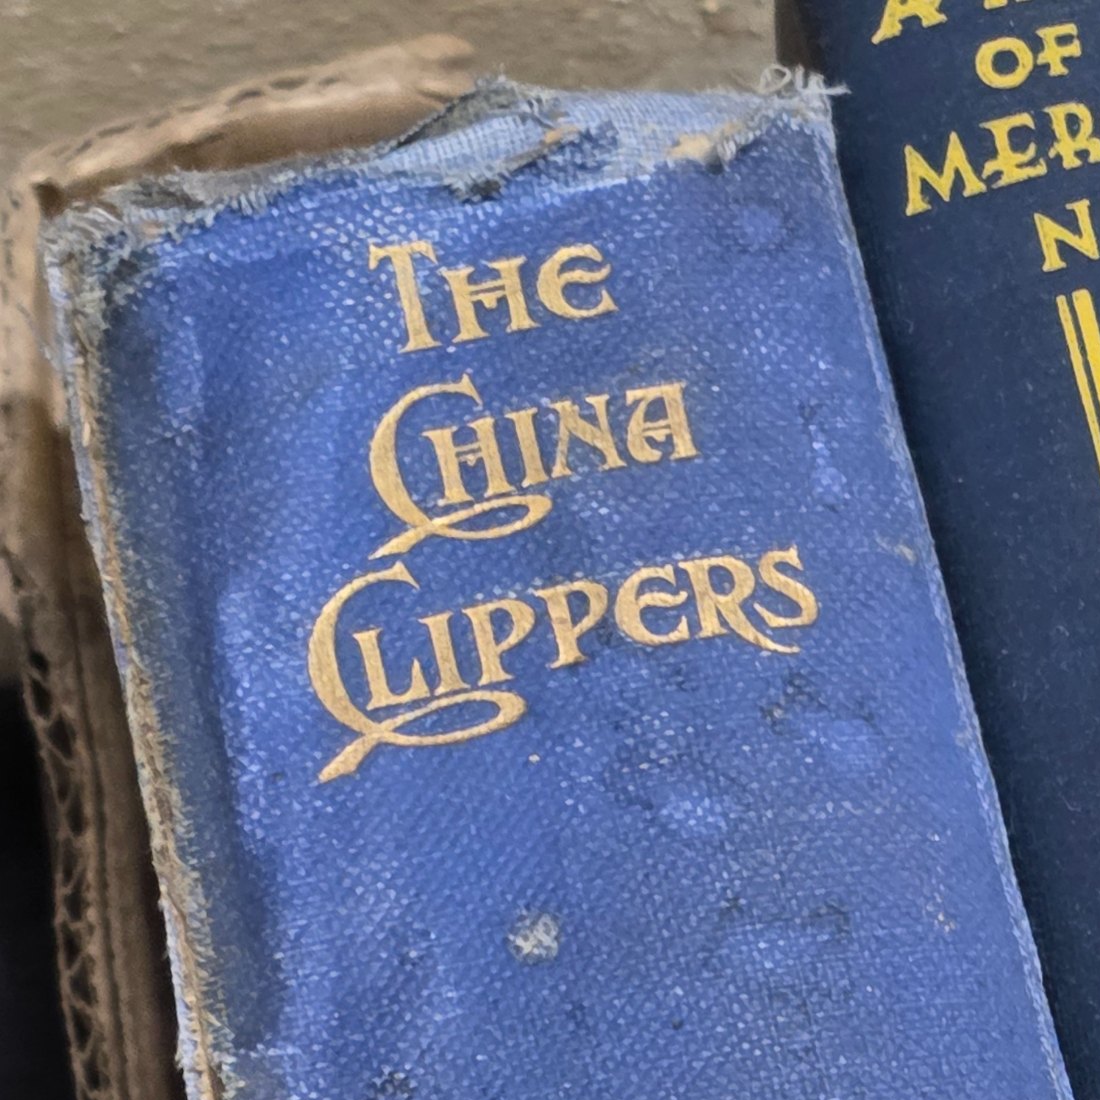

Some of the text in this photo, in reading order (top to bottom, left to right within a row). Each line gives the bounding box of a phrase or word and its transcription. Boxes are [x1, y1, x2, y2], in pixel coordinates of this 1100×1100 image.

[974, 23, 1082, 88] OF
[368, 240, 619, 353] THE
[368, 368, 701, 560] CHINA
[307, 545, 820, 784] CLIPPERS
